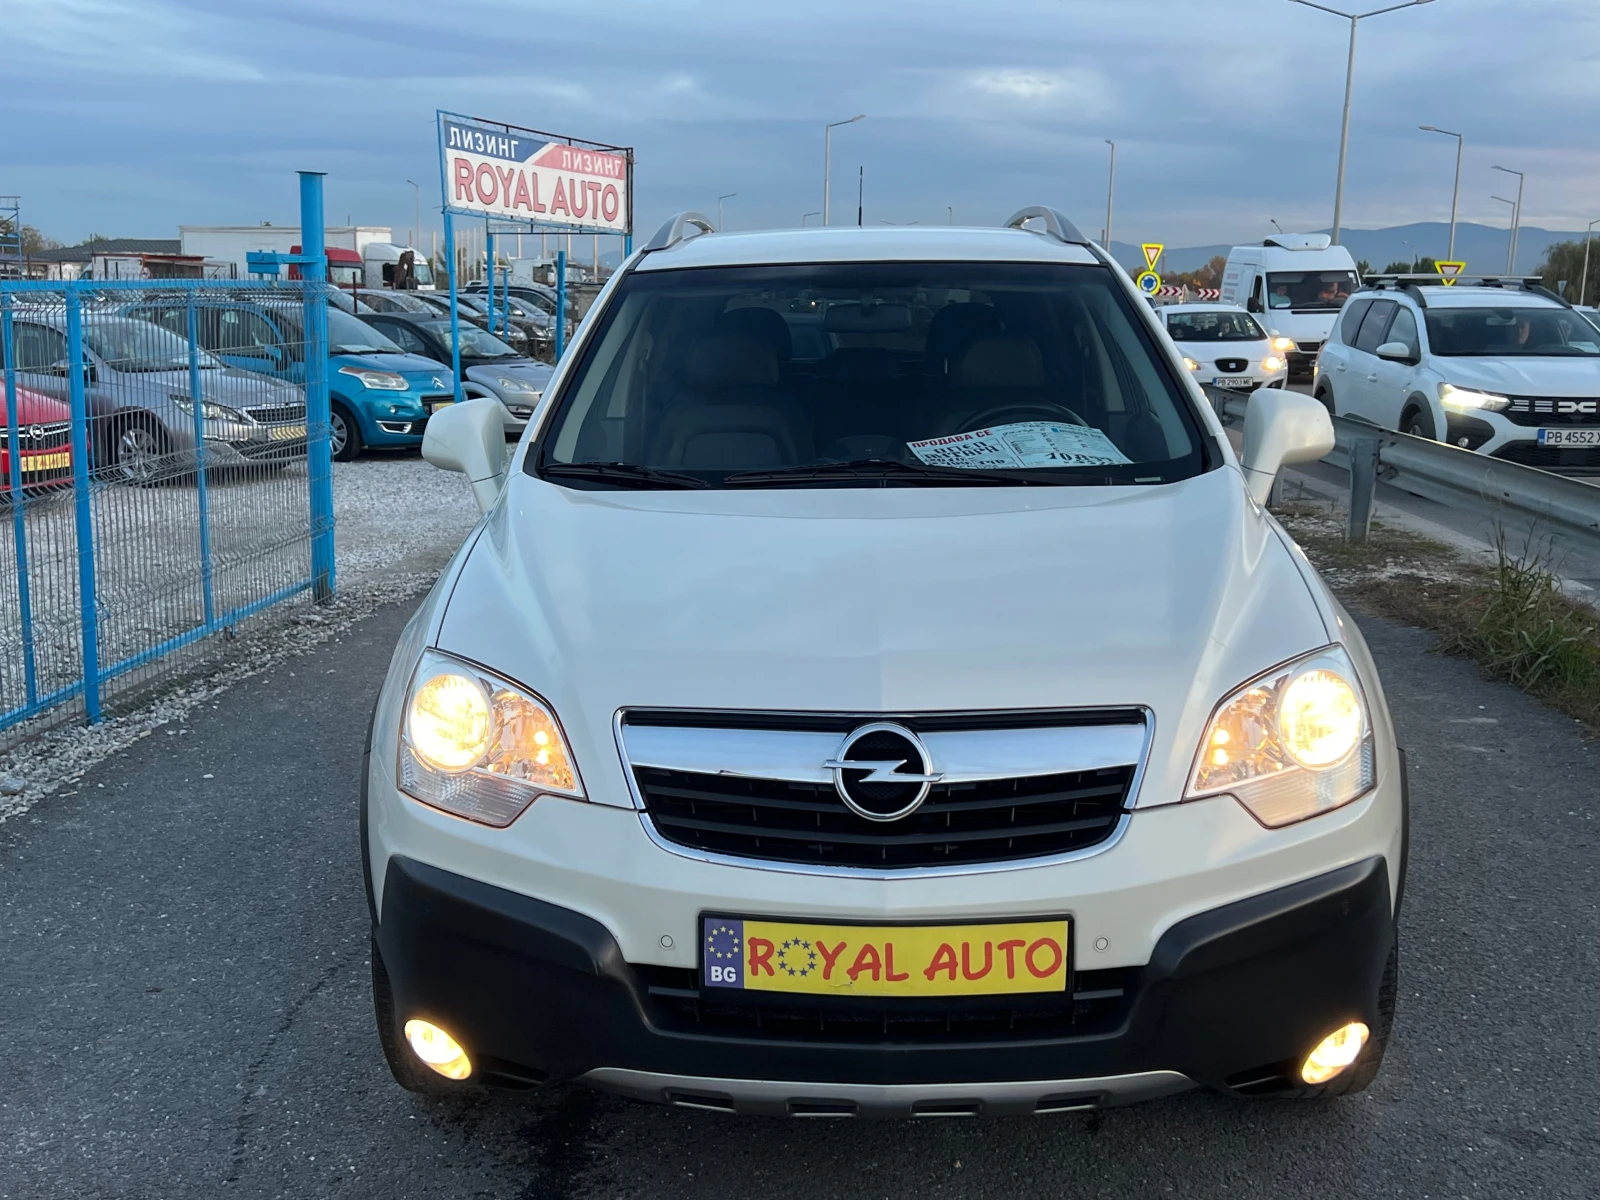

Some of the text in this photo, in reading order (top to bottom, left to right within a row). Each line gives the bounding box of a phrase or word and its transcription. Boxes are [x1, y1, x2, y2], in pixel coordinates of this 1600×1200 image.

[449, 126, 519, 159] ЛИЗИНГ
[562, 150, 622, 176] ЛИЗИНГ
[454, 157, 619, 222] ROYAL AUTO
[912, 434, 973, 448] ПРОДАВА
[975, 429, 993, 438] СЕ
[1546, 431, 1563, 443] PB
[1564, 431, 1594, 443] 4552
[747, 936, 1063, 982] ROYAL AUTO
[710, 965, 737, 983] BG
